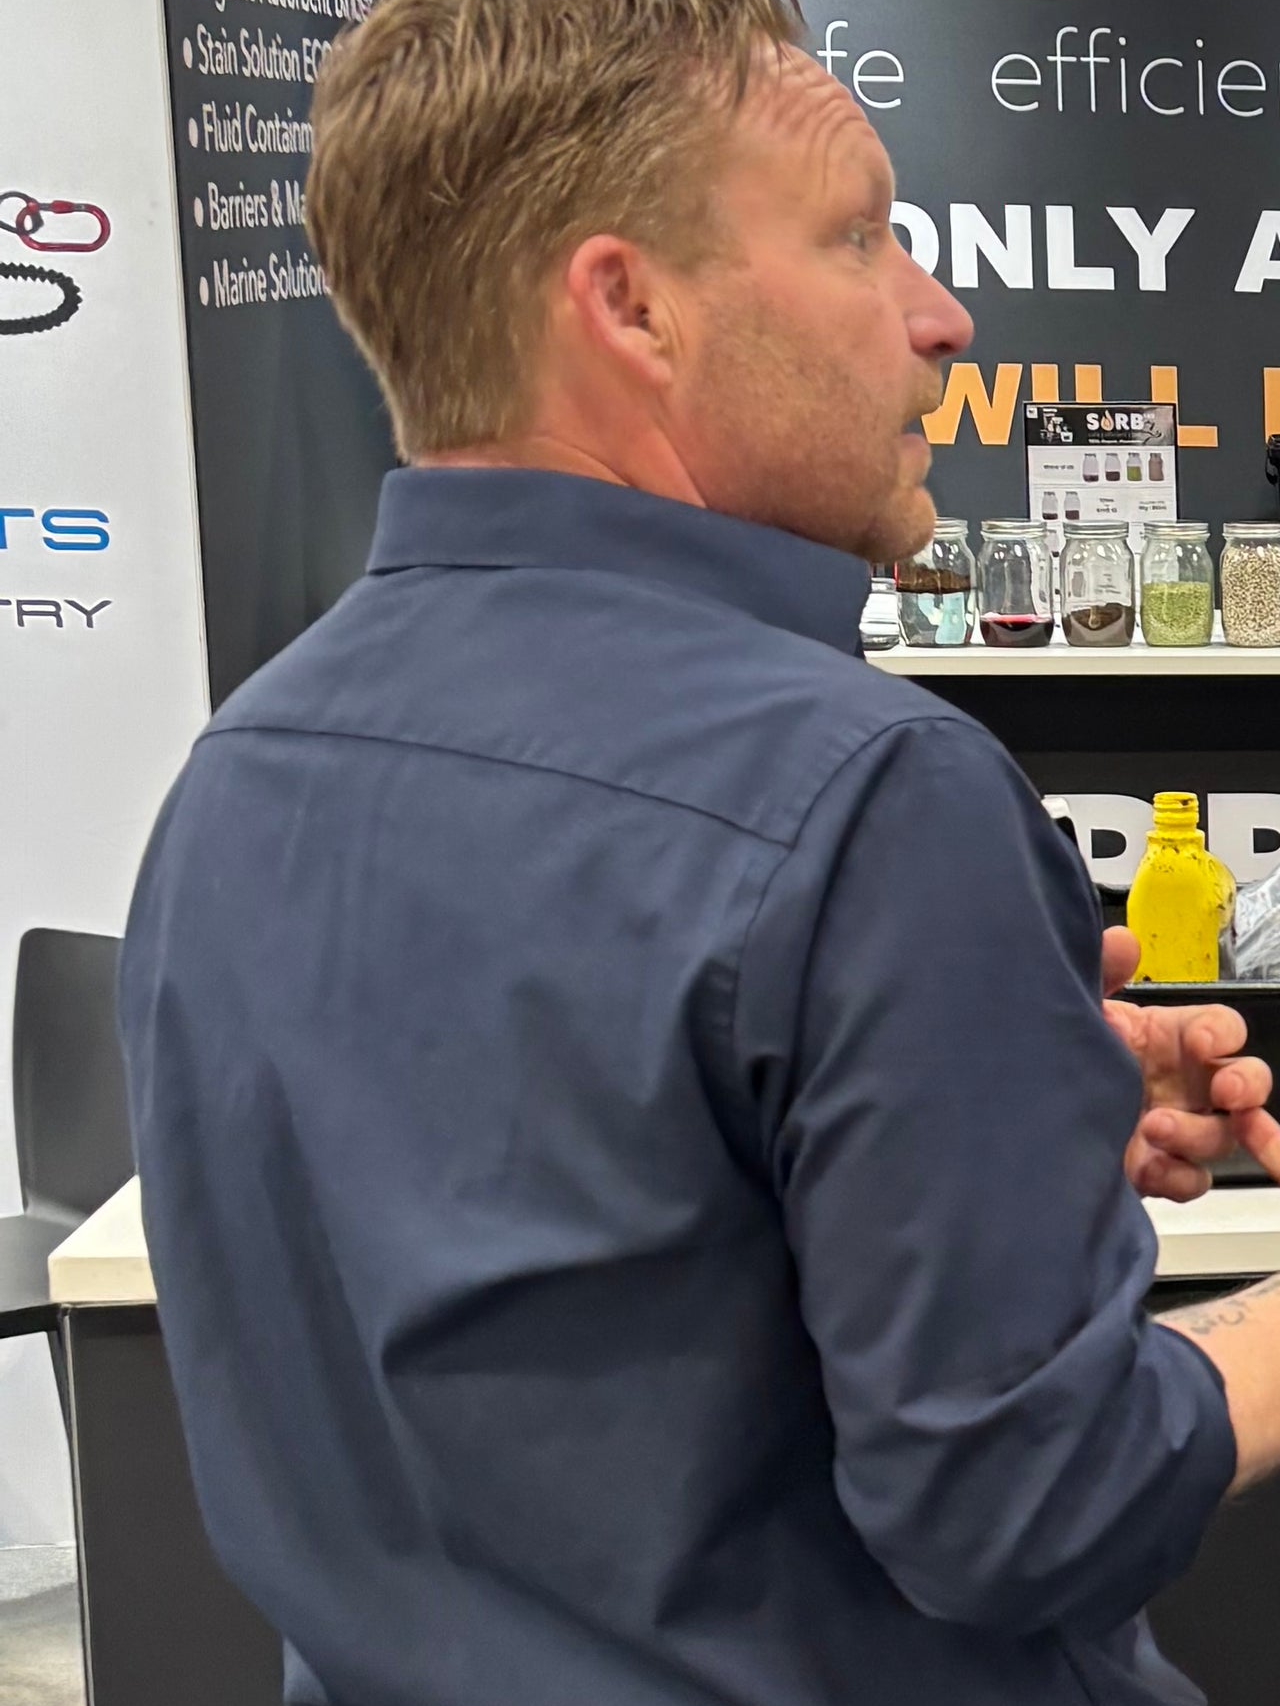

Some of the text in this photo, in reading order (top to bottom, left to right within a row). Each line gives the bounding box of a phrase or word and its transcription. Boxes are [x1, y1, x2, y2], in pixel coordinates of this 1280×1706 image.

[197, 23, 238, 77] Stain
[240, 28, 301, 83] Solution
[816, 20, 905, 111] fe
[201, 102, 313, 155] Fluid Containm
[207, 179, 307, 231] Barriers & Ma
[212, 259, 267, 308] Marine
